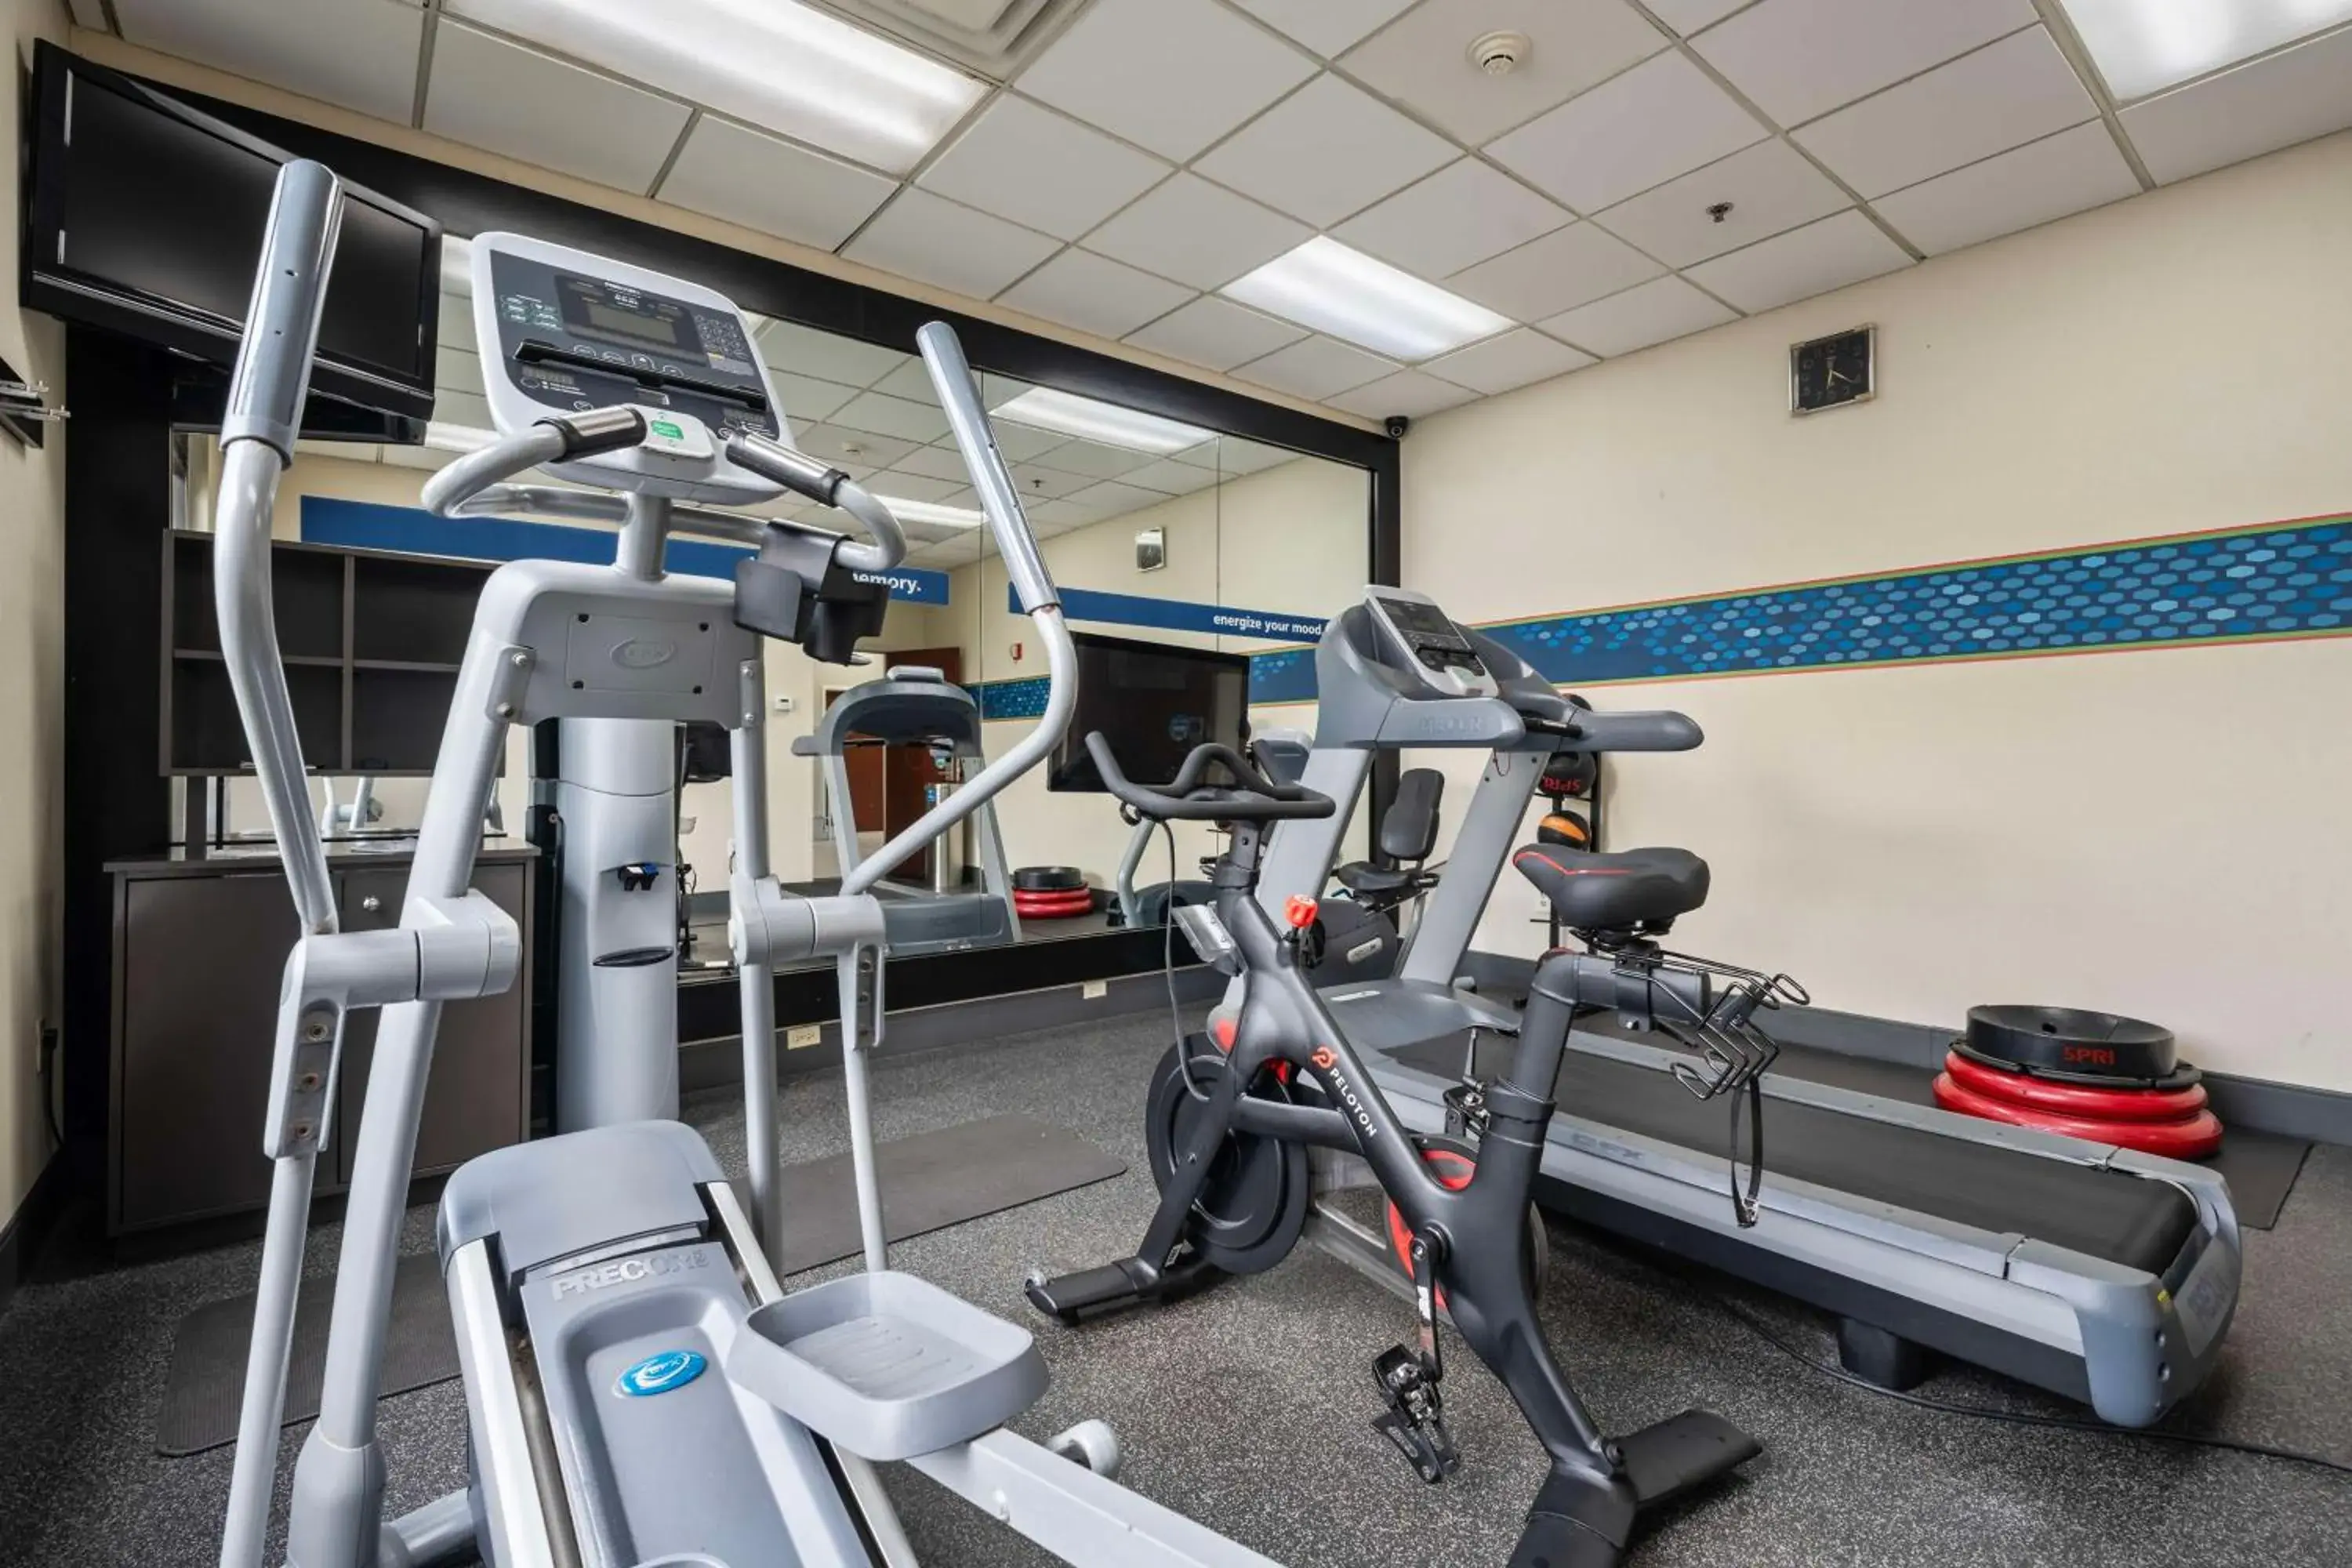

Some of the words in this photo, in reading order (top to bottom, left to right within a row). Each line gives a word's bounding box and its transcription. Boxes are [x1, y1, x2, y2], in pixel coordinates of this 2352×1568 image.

[1214, 615, 1261, 630] energize
[1265, 620, 1290, 633] your
[1292, 623, 1322, 635] mood
[2063, 1046, 2115, 1065] SPRI
[1330, 1068, 1377, 1137] PELOTON
